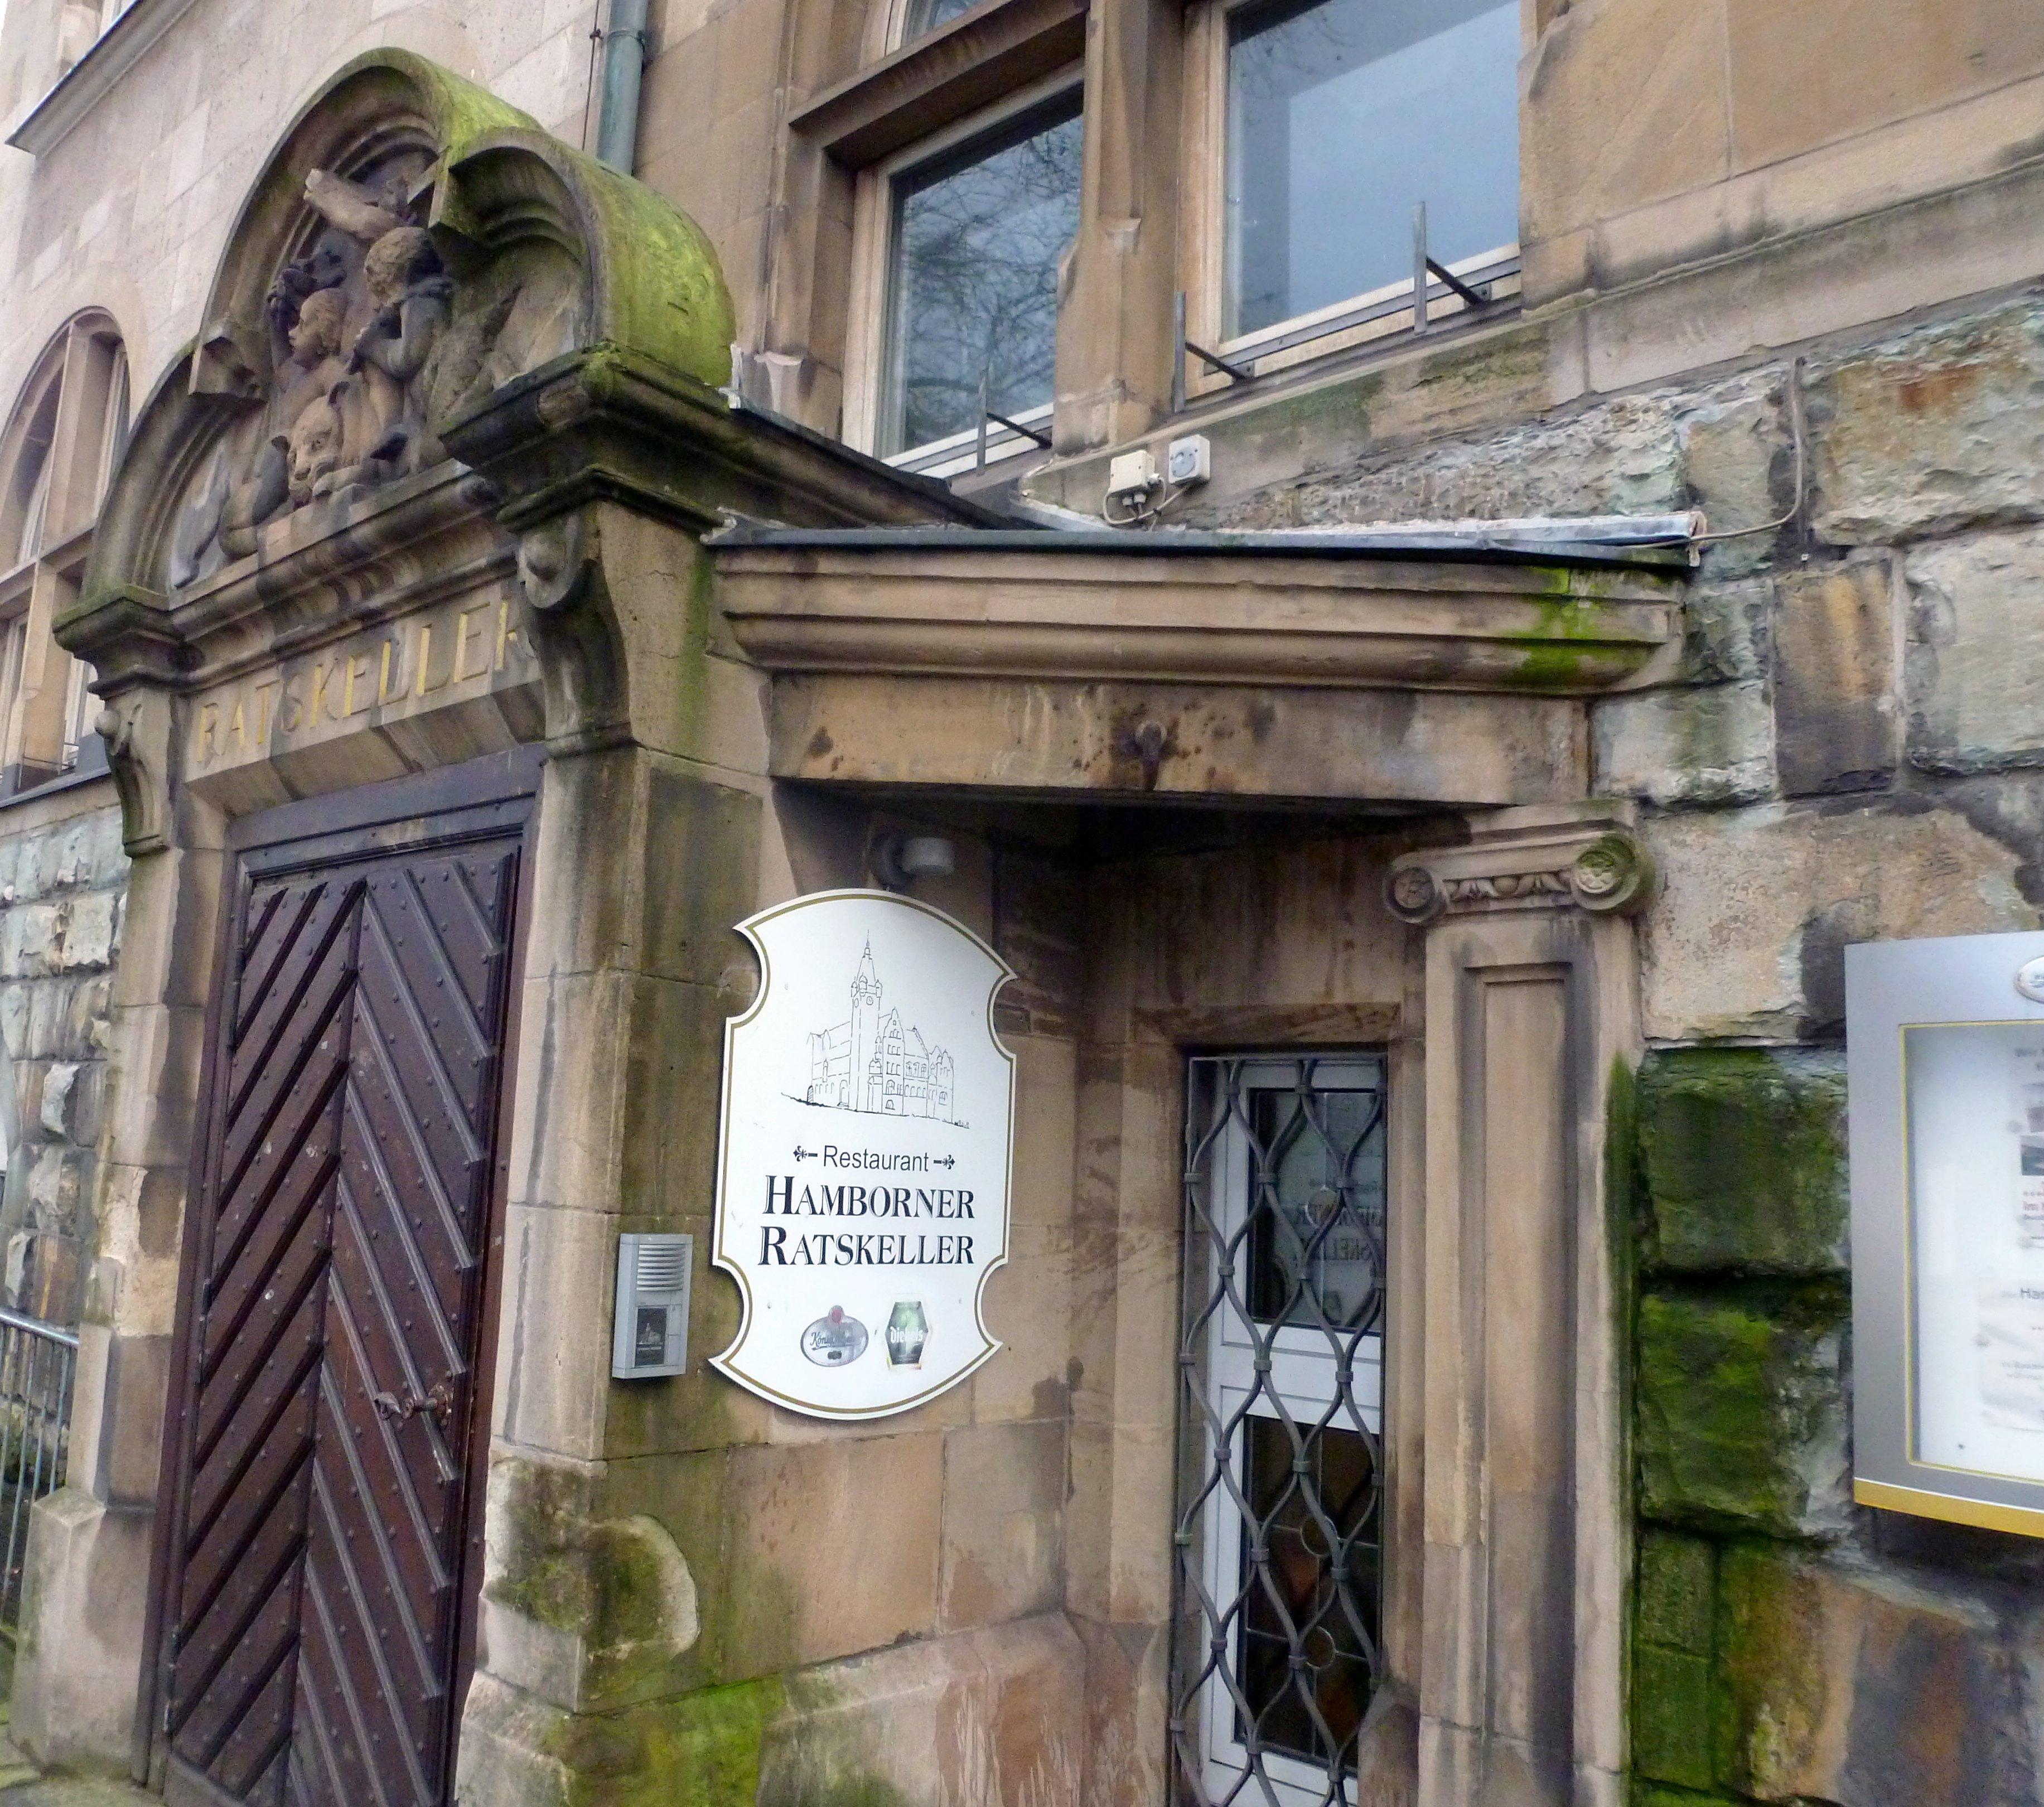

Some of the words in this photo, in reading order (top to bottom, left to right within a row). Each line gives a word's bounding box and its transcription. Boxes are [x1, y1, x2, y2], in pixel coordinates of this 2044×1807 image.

[823, 1145, 929, 1171] Restaurant
[762, 1175, 974, 1219] HAMBORNER
[758, 1226, 974, 1265] RATSKELLER
[890, 1326, 924, 1344] Diels
